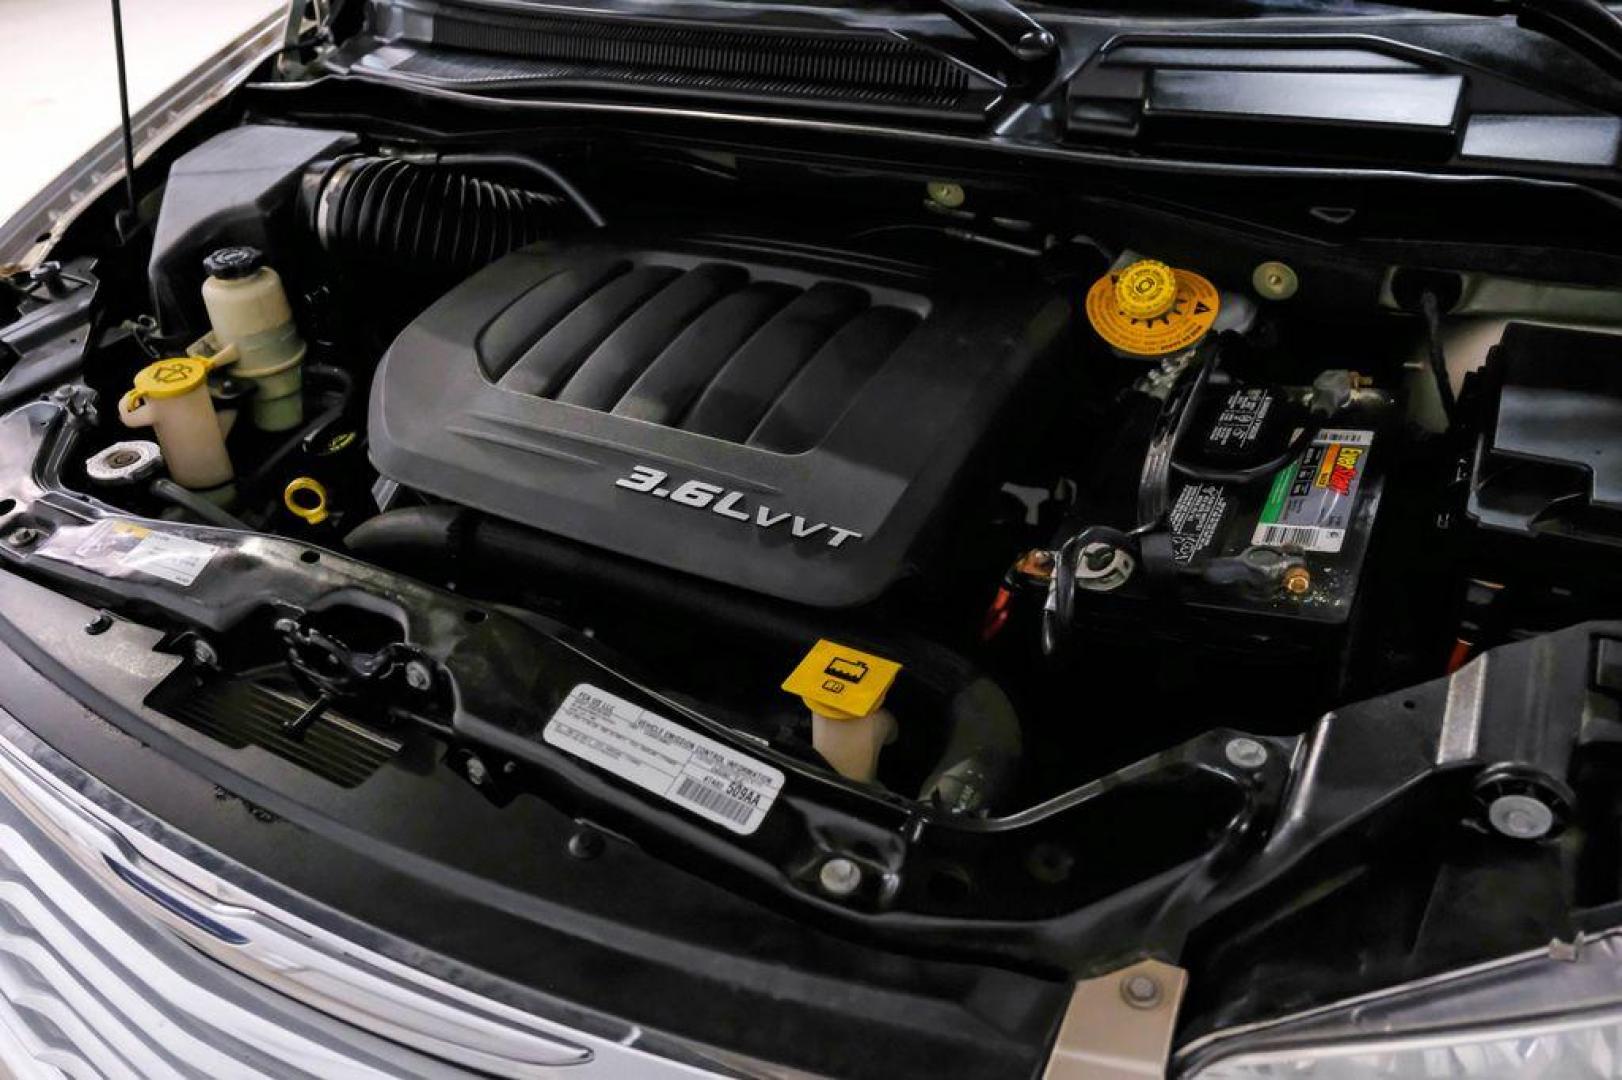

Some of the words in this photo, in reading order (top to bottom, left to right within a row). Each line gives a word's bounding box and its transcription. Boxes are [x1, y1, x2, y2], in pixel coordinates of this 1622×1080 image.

[664, 729, 695, 751] EMISSION
[695, 742, 725, 763] CONTROL
[725, 755, 773, 783] INFORMATION
[726, 782, 761, 806] 509AA
